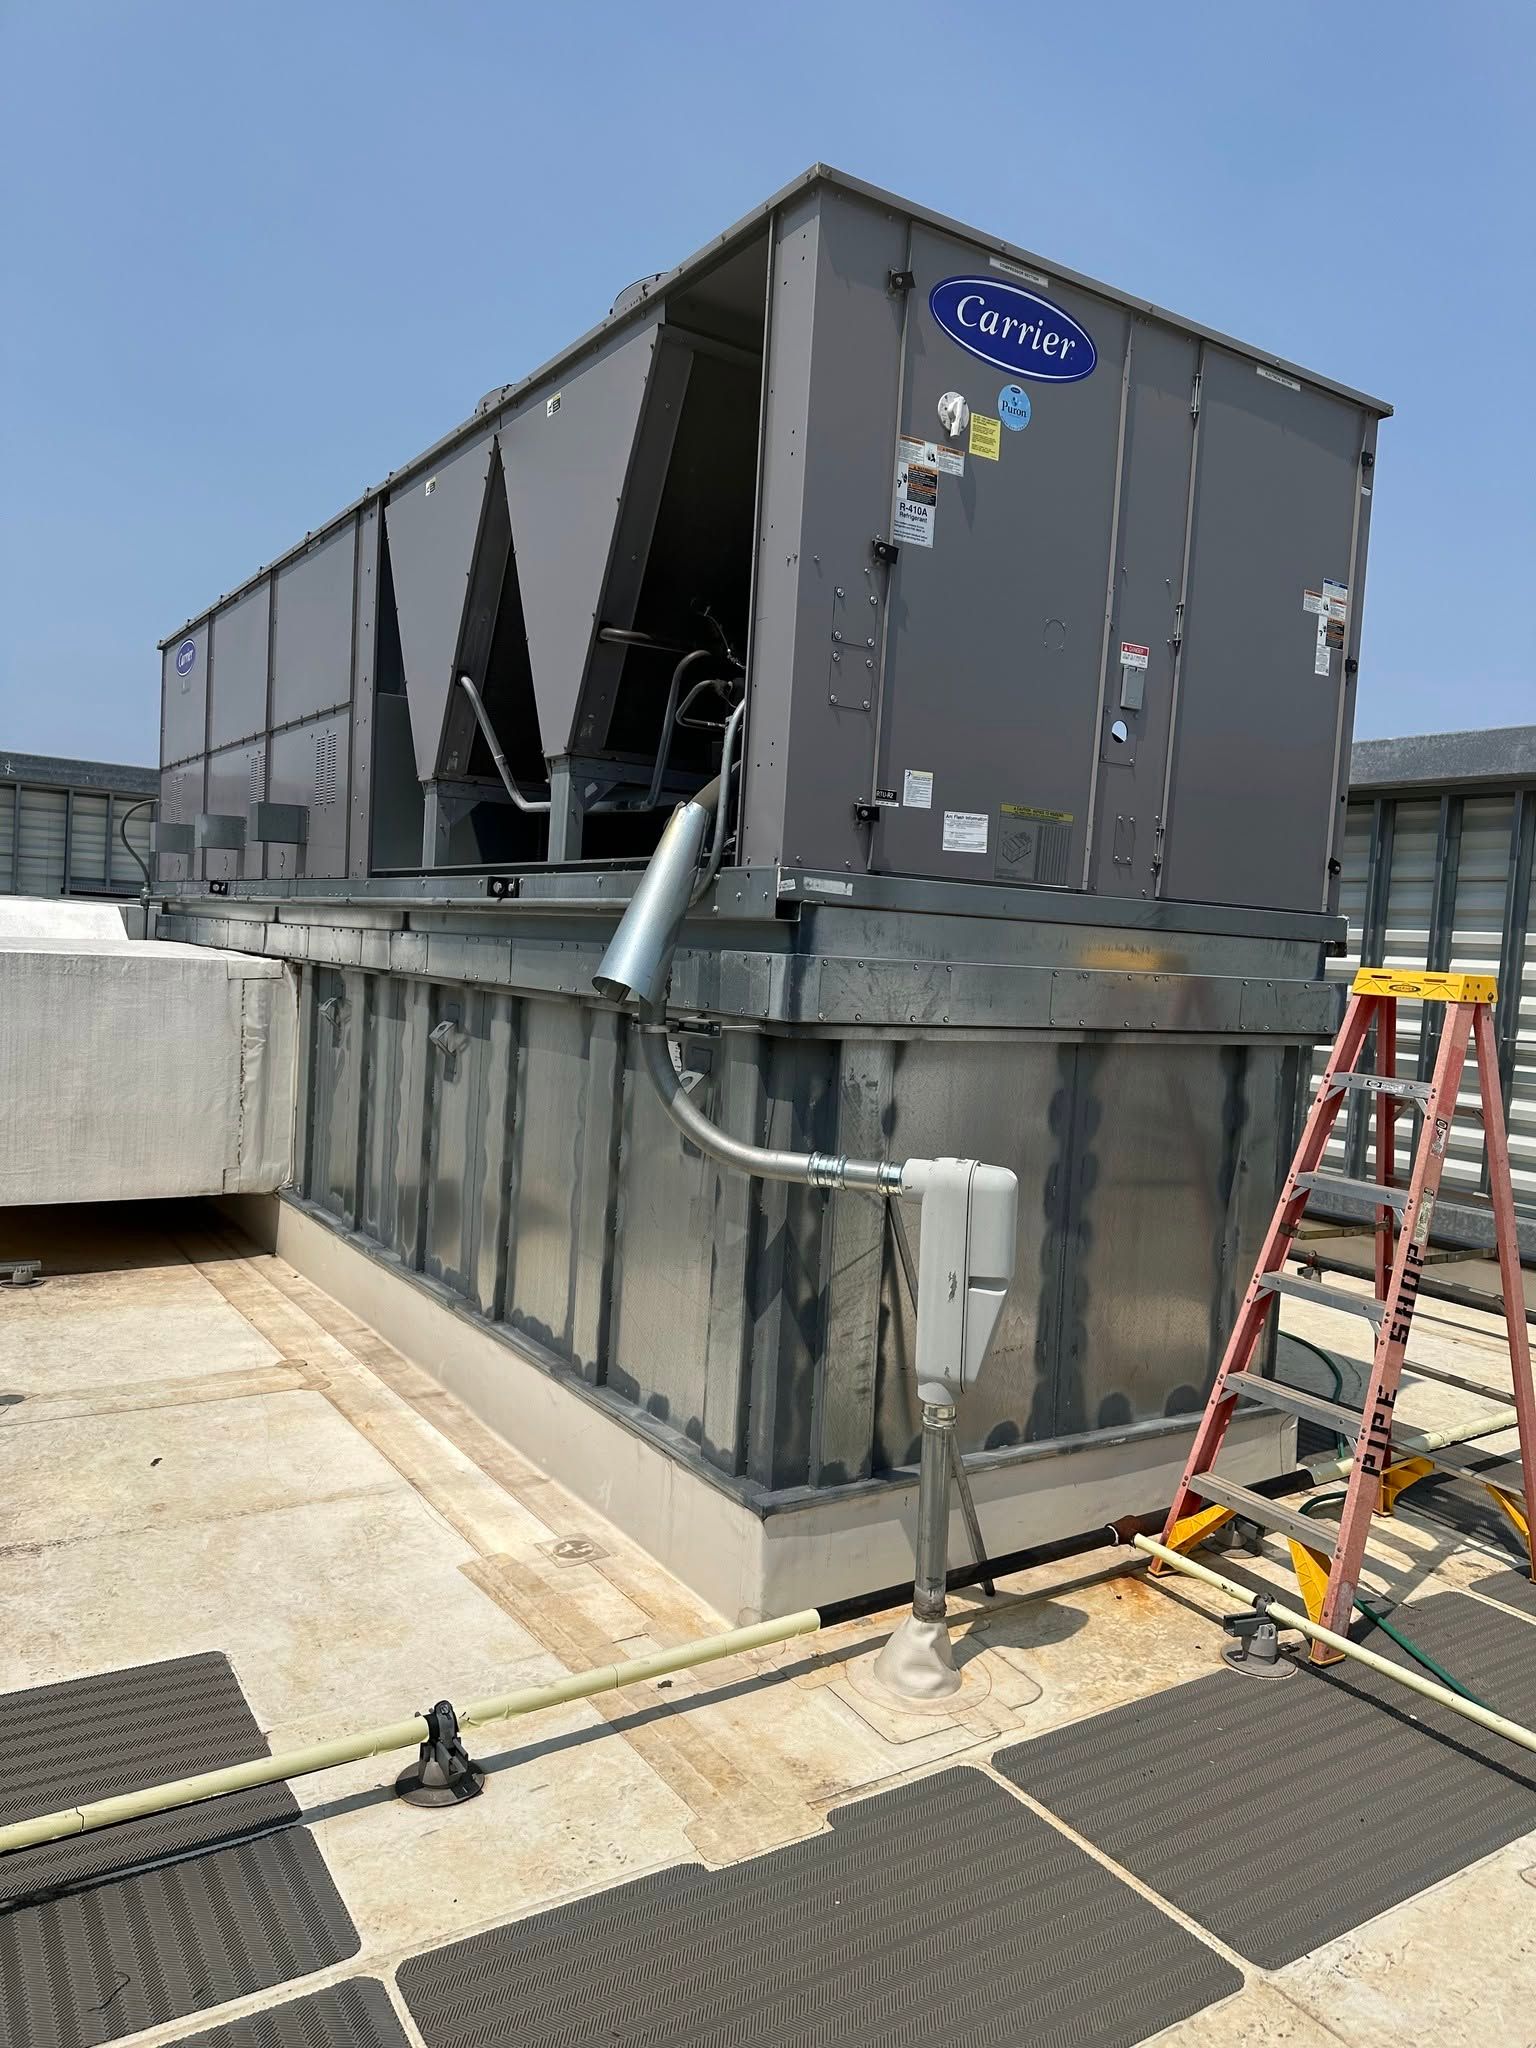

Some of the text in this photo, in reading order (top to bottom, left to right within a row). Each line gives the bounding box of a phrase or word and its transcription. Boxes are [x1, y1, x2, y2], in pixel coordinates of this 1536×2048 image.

[956, 295, 1076, 360] Carrier
[1002, 400, 1027, 417] Puron
[899, 502, 928, 517] R-410A
[900, 511, 928, 523] Refrigerant
[1361, 1385, 1398, 1477] PIPE
[1389, 1243, 1424, 1344] SHOP
